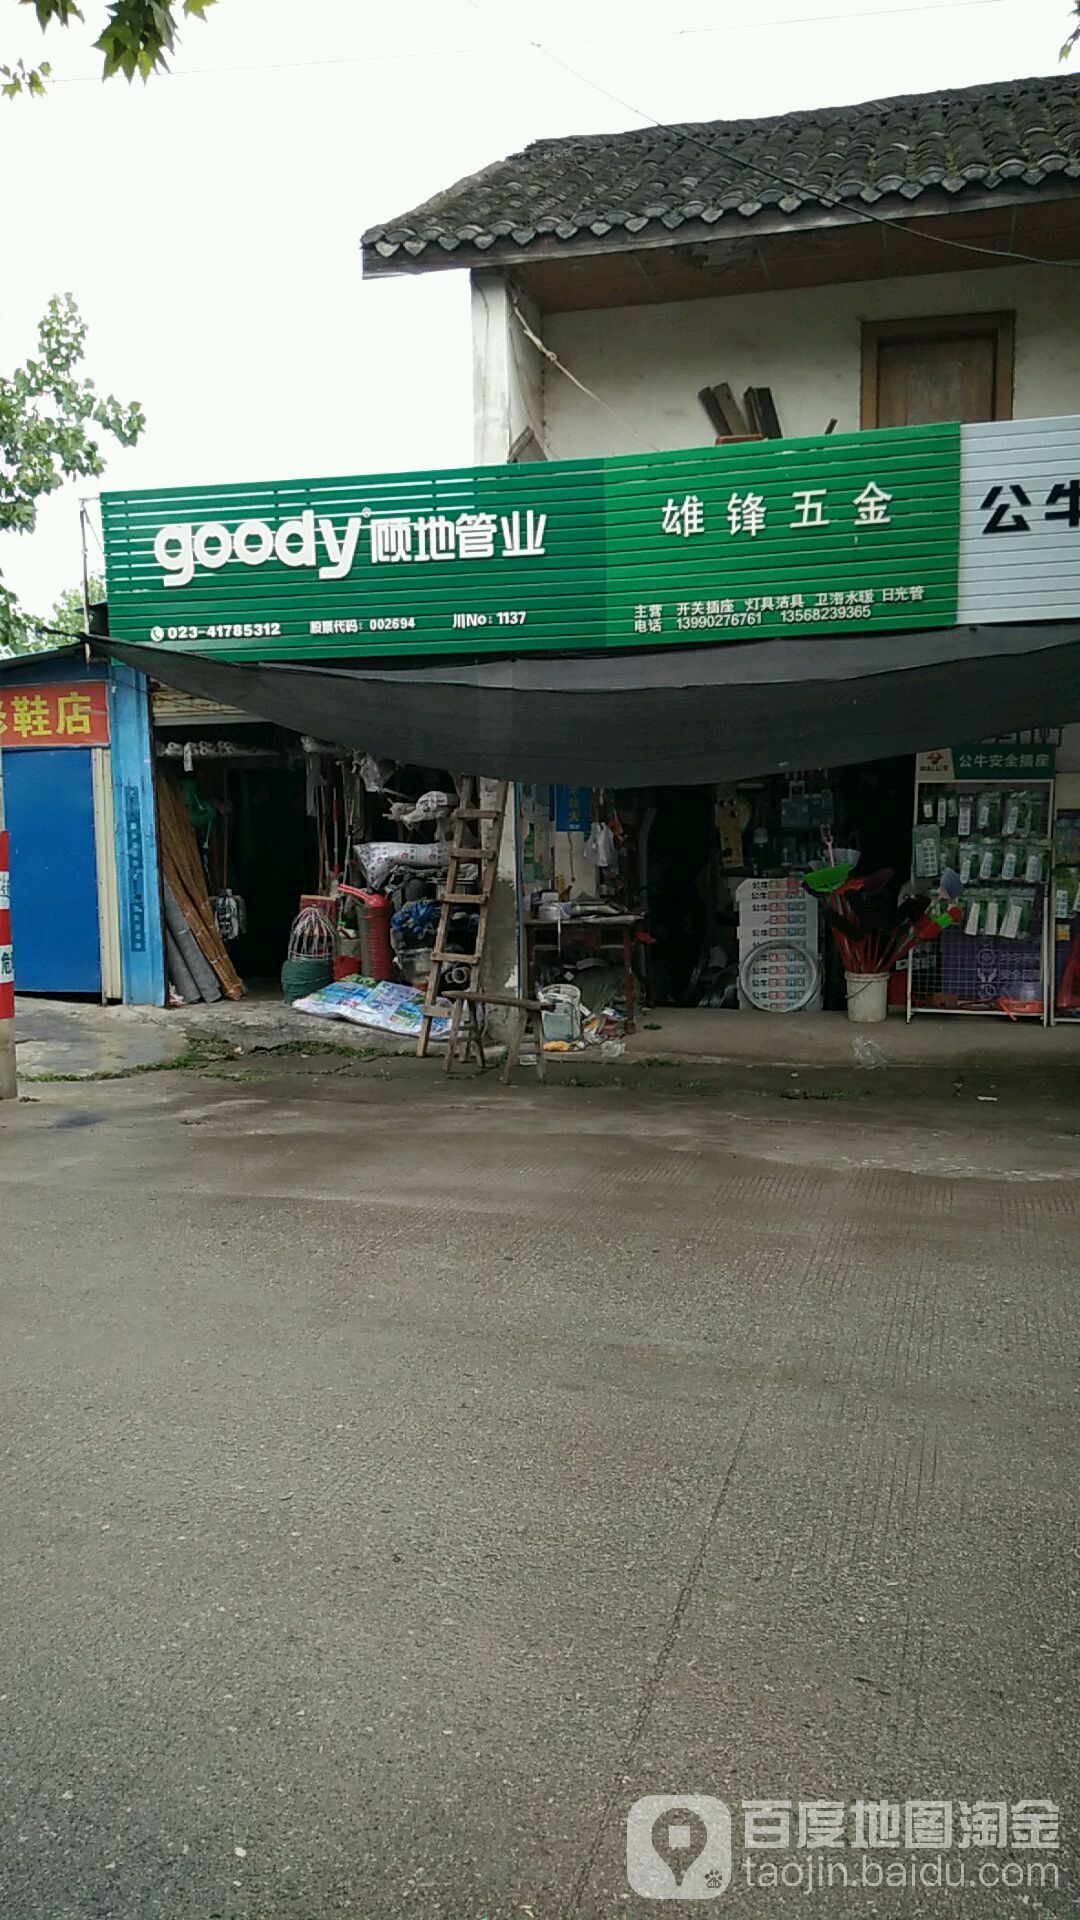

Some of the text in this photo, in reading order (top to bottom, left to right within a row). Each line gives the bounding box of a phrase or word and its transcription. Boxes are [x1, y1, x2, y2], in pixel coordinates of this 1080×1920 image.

[661, 481, 894, 538] 雄锋五金
[153, 509, 547, 587] goody 顾地管业
[634, 604, 663, 618] 主营
[677, 599, 734, 616] 开关插座
[745, 594, 804, 611] 灯具洁具
[814, 588, 874, 607] 卫浴水暖
[369, 617, 416, 632] 002694
[496, 611, 527, 625] 1137
[634, 605, 872, 633] 电话 13990276761 13568239365
[168, 622, 281, 640] 023-41785312
[959, 753, 1050, 769] 公牛安全插座
